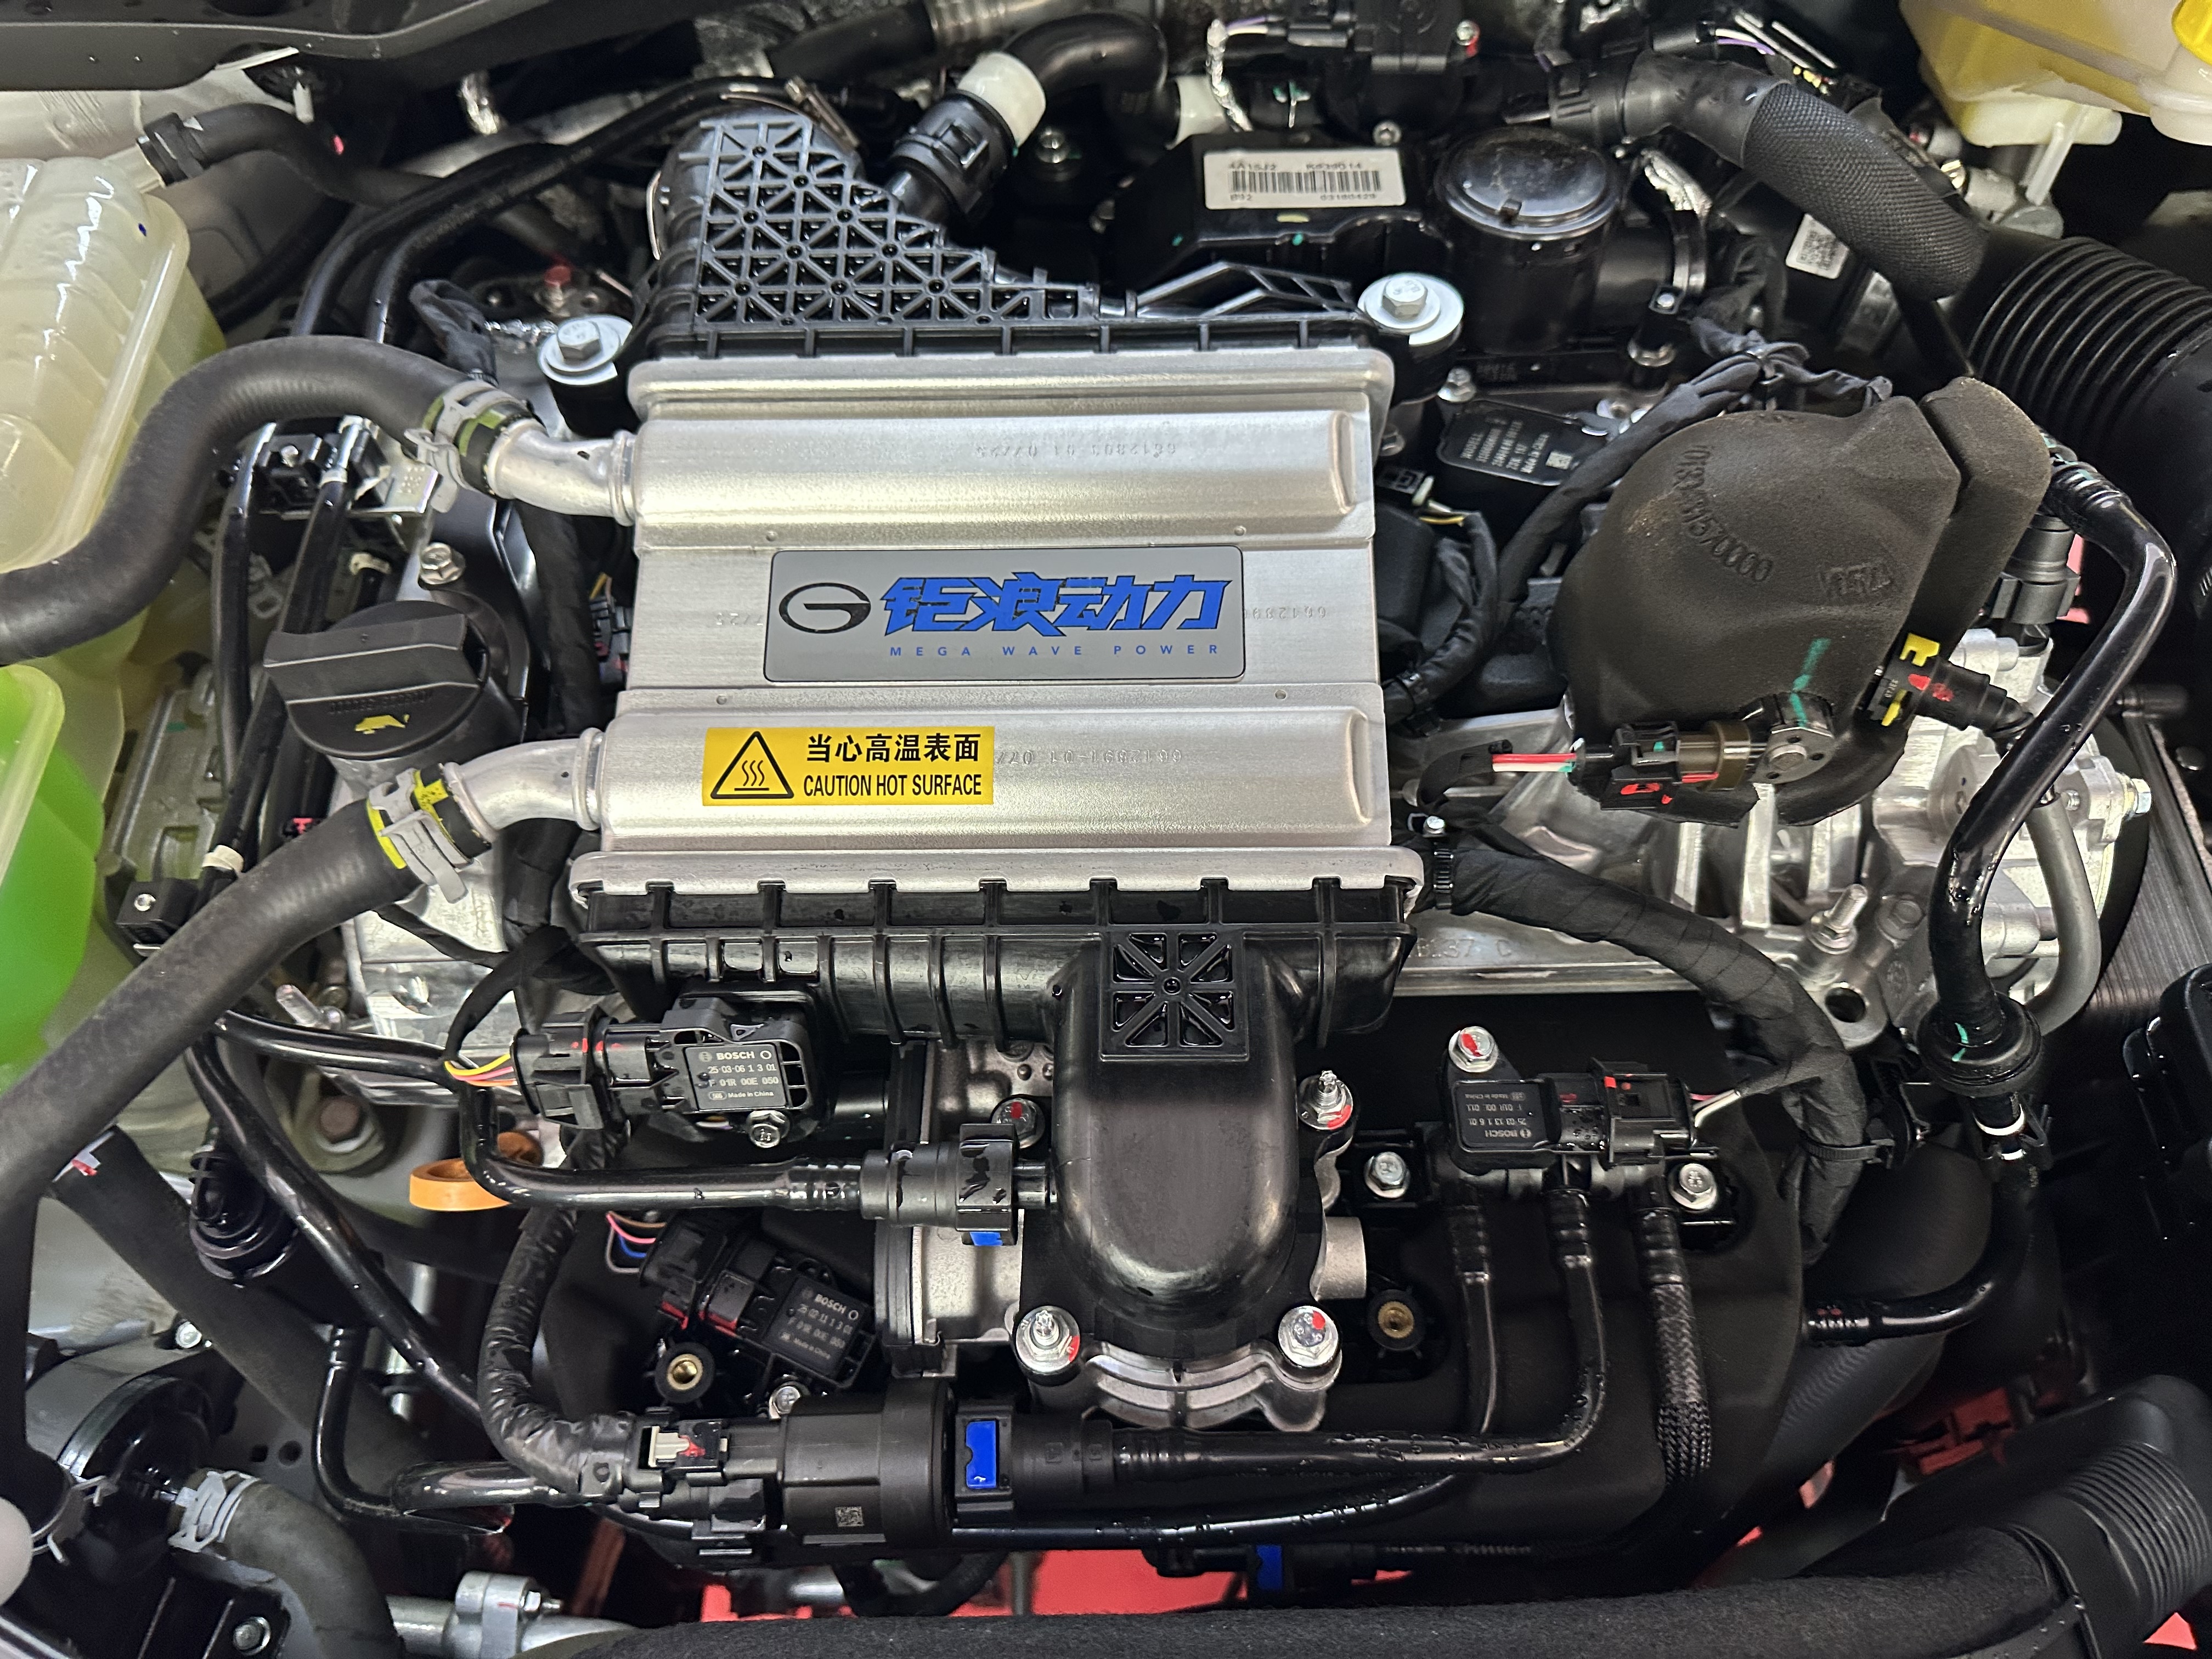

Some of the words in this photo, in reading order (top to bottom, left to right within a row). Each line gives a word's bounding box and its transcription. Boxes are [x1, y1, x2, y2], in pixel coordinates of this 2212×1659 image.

[879, 572, 1233, 637] 钜浪动力
[890, 646, 971, 657] MEGA
[1002, 645, 1082, 657] WAVE
[1114, 644, 1218, 656] POWER
[807, 732, 981, 763] 当心高温表面
[803, 775, 872, 797] CAUTION
[877, 774, 908, 796] HOT
[912, 774, 982, 796] SURFACE
[716, 1051, 755, 1060] BOSCH
[748, 1064, 754, 1073] 1
[757, 1064, 763, 1072] 3
[766, 1063, 777, 1071] 01
[719, 1078, 737, 1087] 01R
[740, 1077, 758, 1086] 00E
[761, 1076, 779, 1085] 050
[1485, 1130, 1519, 1138] BOSCH
[814, 1293, 847, 1314] BOSCH
